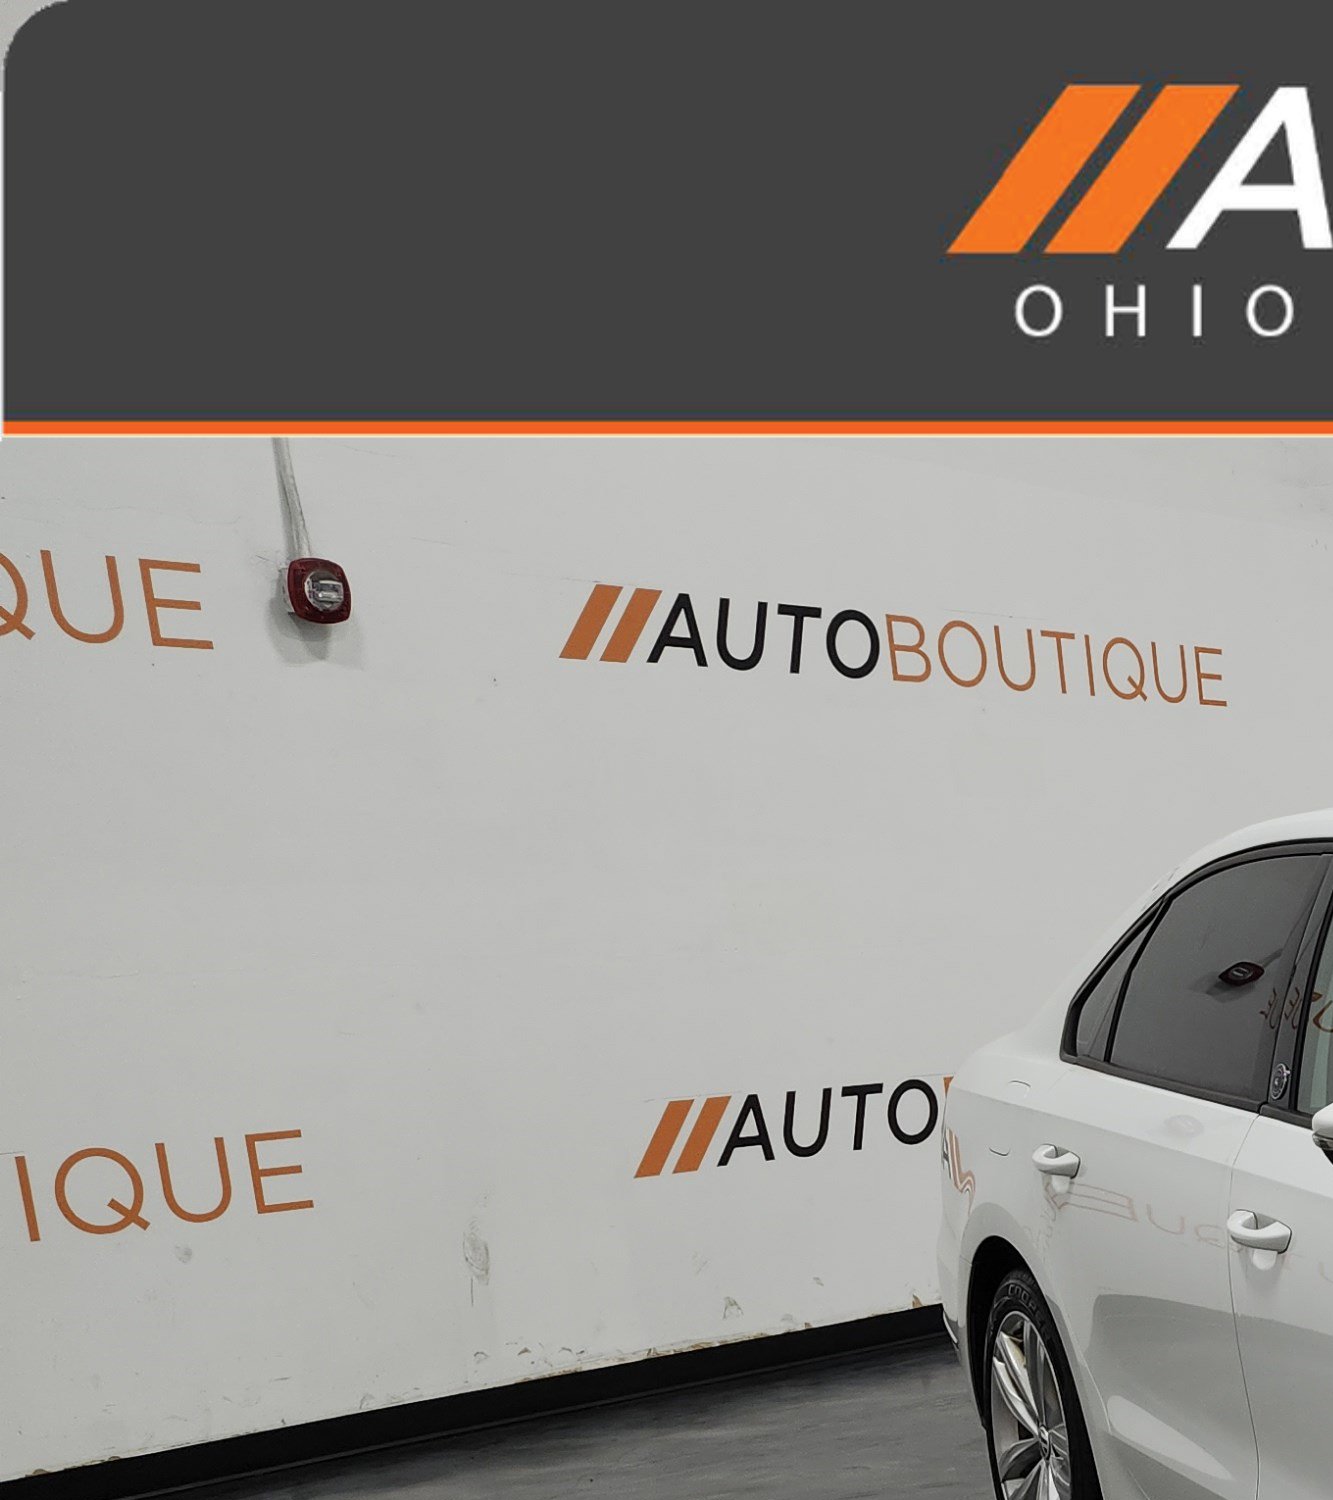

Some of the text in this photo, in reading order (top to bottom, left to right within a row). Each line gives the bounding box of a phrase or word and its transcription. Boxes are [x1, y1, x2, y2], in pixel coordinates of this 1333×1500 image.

[646, 593, 1228, 707] AUTOBOUTIQUE
[716, 1075, 954, 1168] AUTO
[15, 1129, 314, 1242] IQUE
